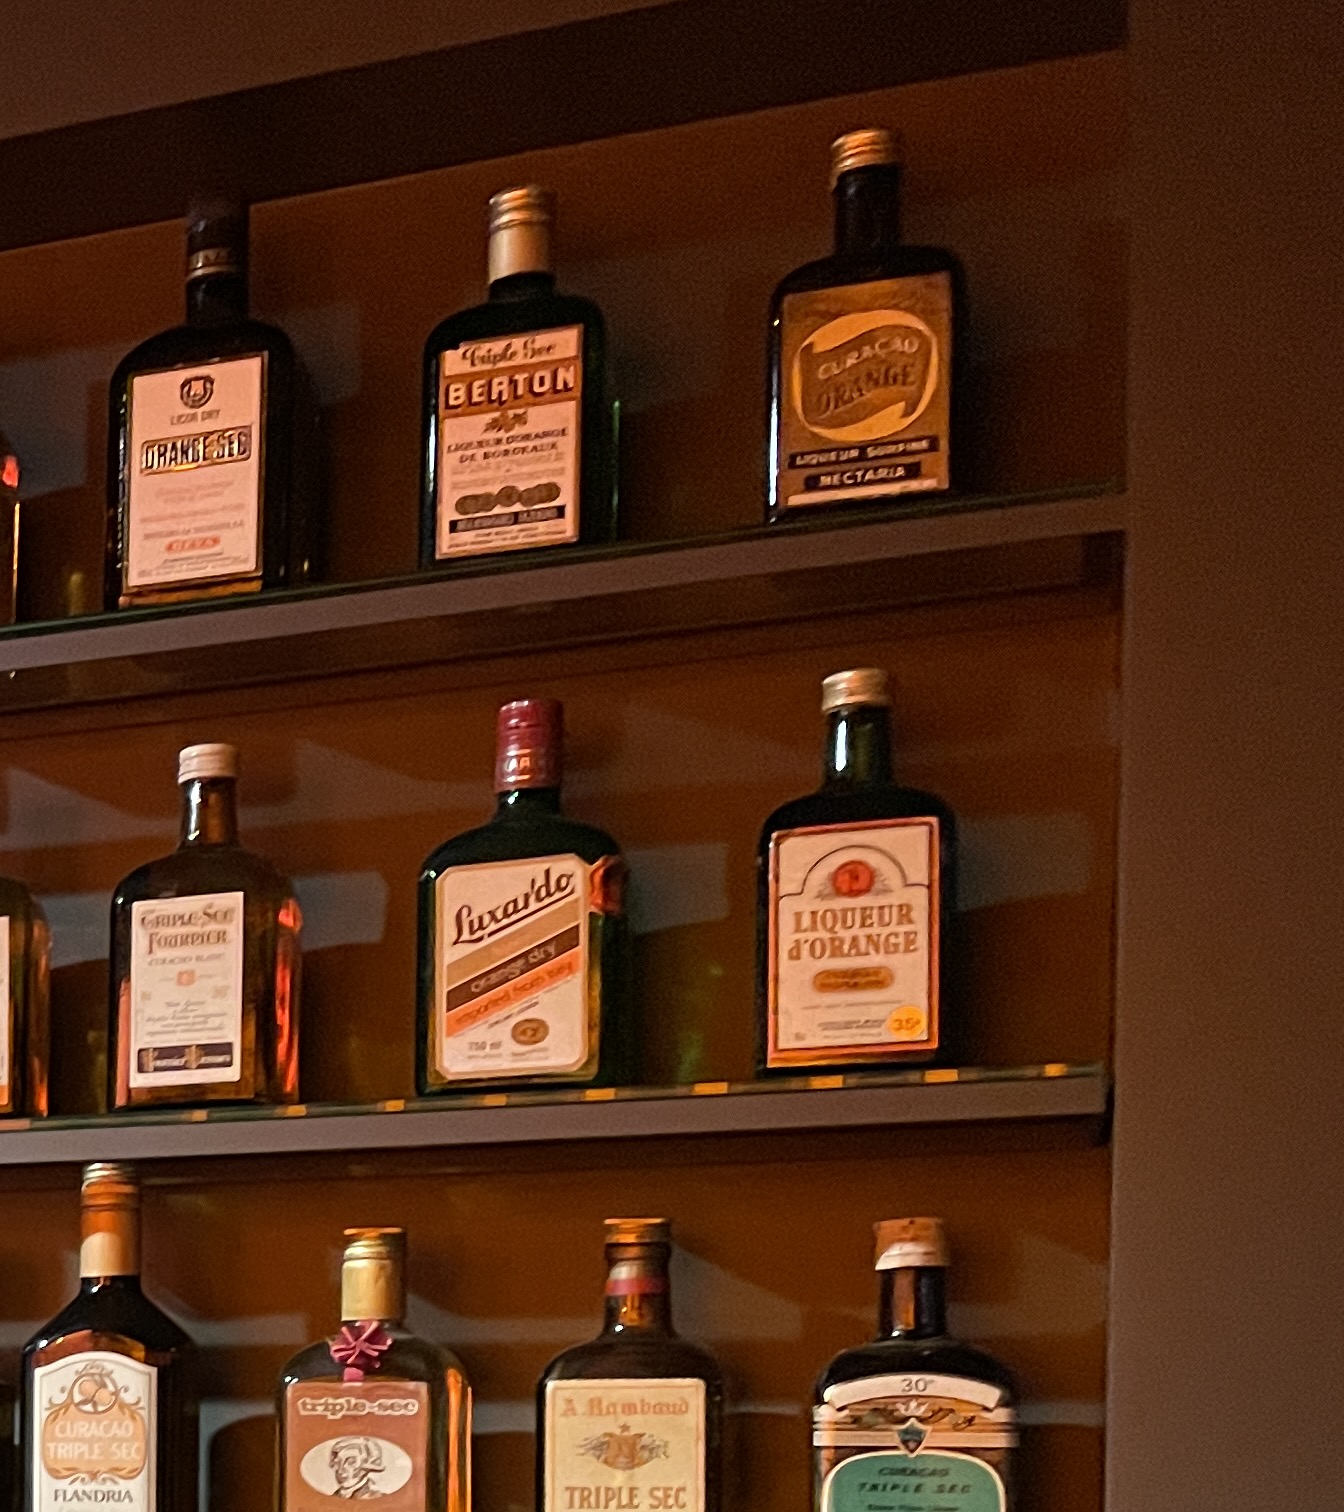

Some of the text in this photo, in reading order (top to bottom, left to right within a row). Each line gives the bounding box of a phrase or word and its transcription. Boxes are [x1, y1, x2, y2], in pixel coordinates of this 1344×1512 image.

[818, 338, 920, 377] CURAÇAO
[445, 366, 576, 410] BERTON
[815, 366, 917, 416] ORANGE
[818, 465, 906, 487] NECTARIA
[451, 868, 573, 946] Luxardo
[792, 903, 915, 934] LIQUEUR
[788, 931, 919, 961] d'ORANGE
[56, 1420, 133, 1440] CURAÇAO
[47, 1441, 141, 1460] TRIPLE SEC
[53, 1489, 134, 1504] FLANDRIA
[565, 1487, 687, 1510] TRIPLE SEC
[857, 1482, 973, 1494] TRIPLE SEC
